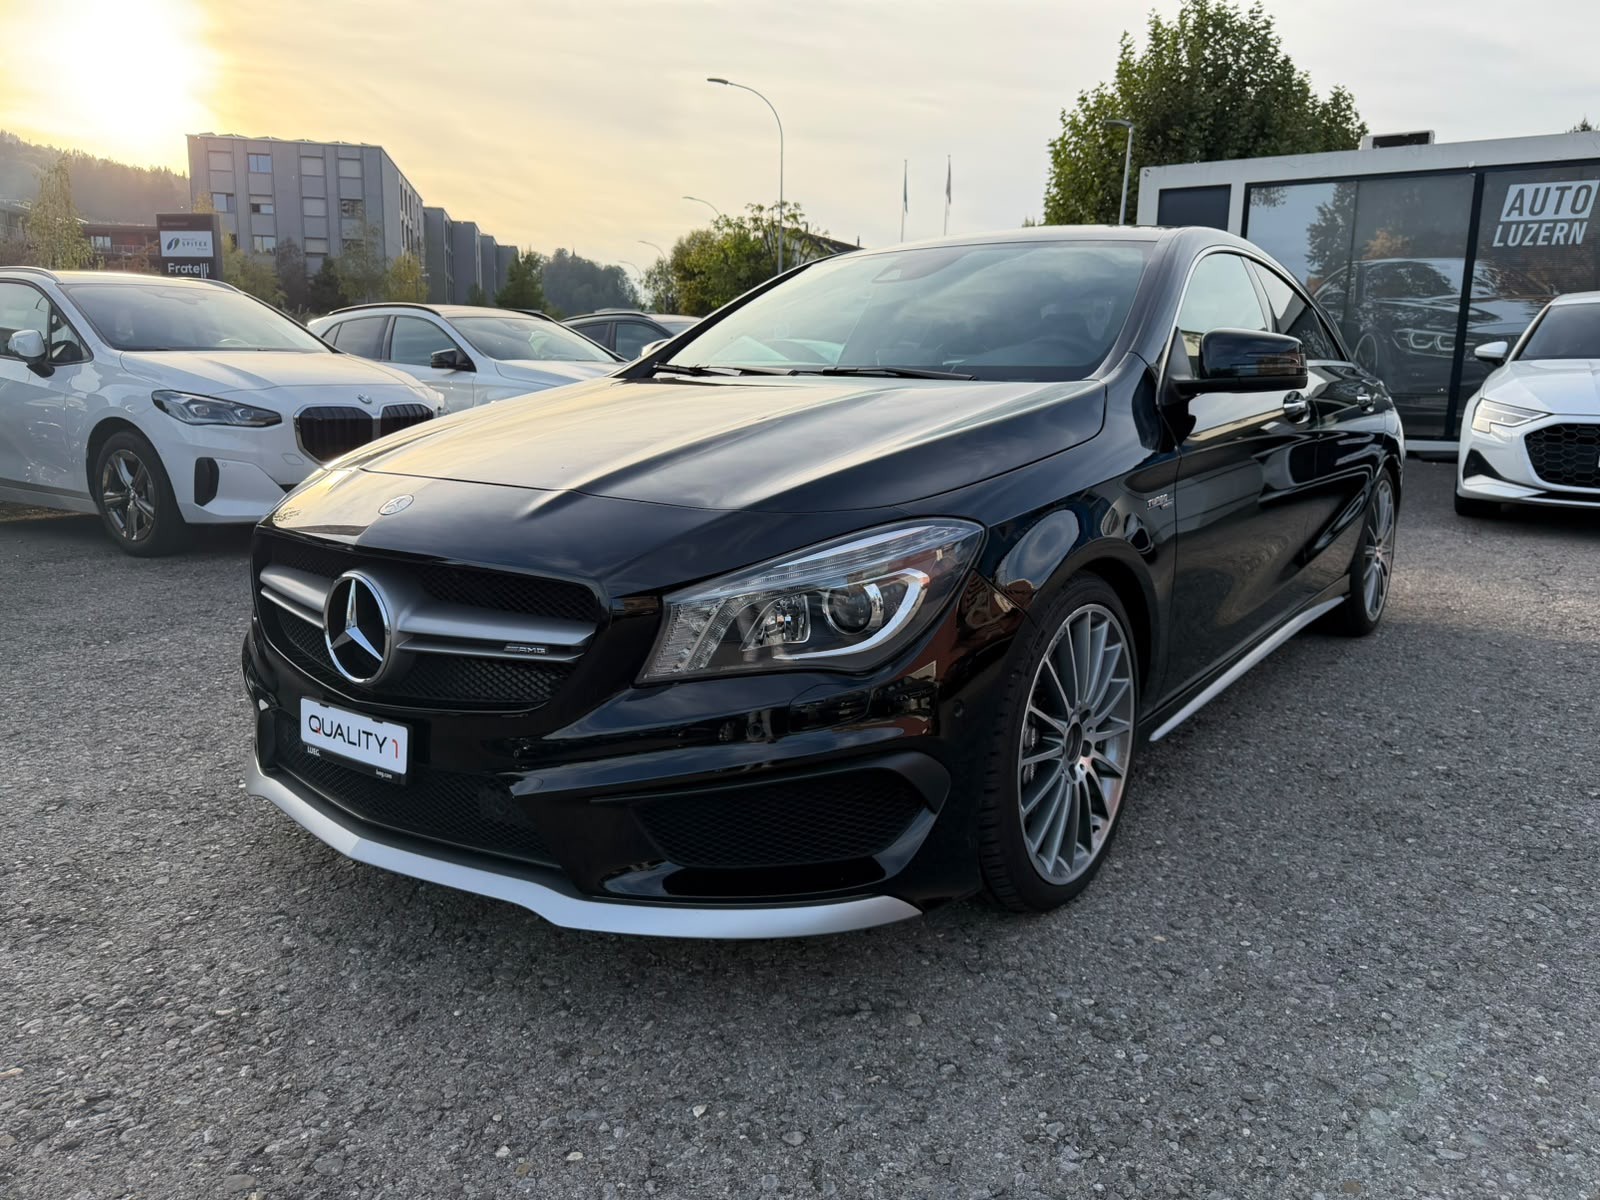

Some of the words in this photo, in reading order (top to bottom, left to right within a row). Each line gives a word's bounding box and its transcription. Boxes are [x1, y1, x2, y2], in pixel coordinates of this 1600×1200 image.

[1505, 185, 1593, 218] AUTO
[1492, 221, 1588, 247] LUZERN
[167, 262, 209, 279] Fratelli
[308, 714, 388, 754] QUALITY
[392, 738, 398, 759] 1
